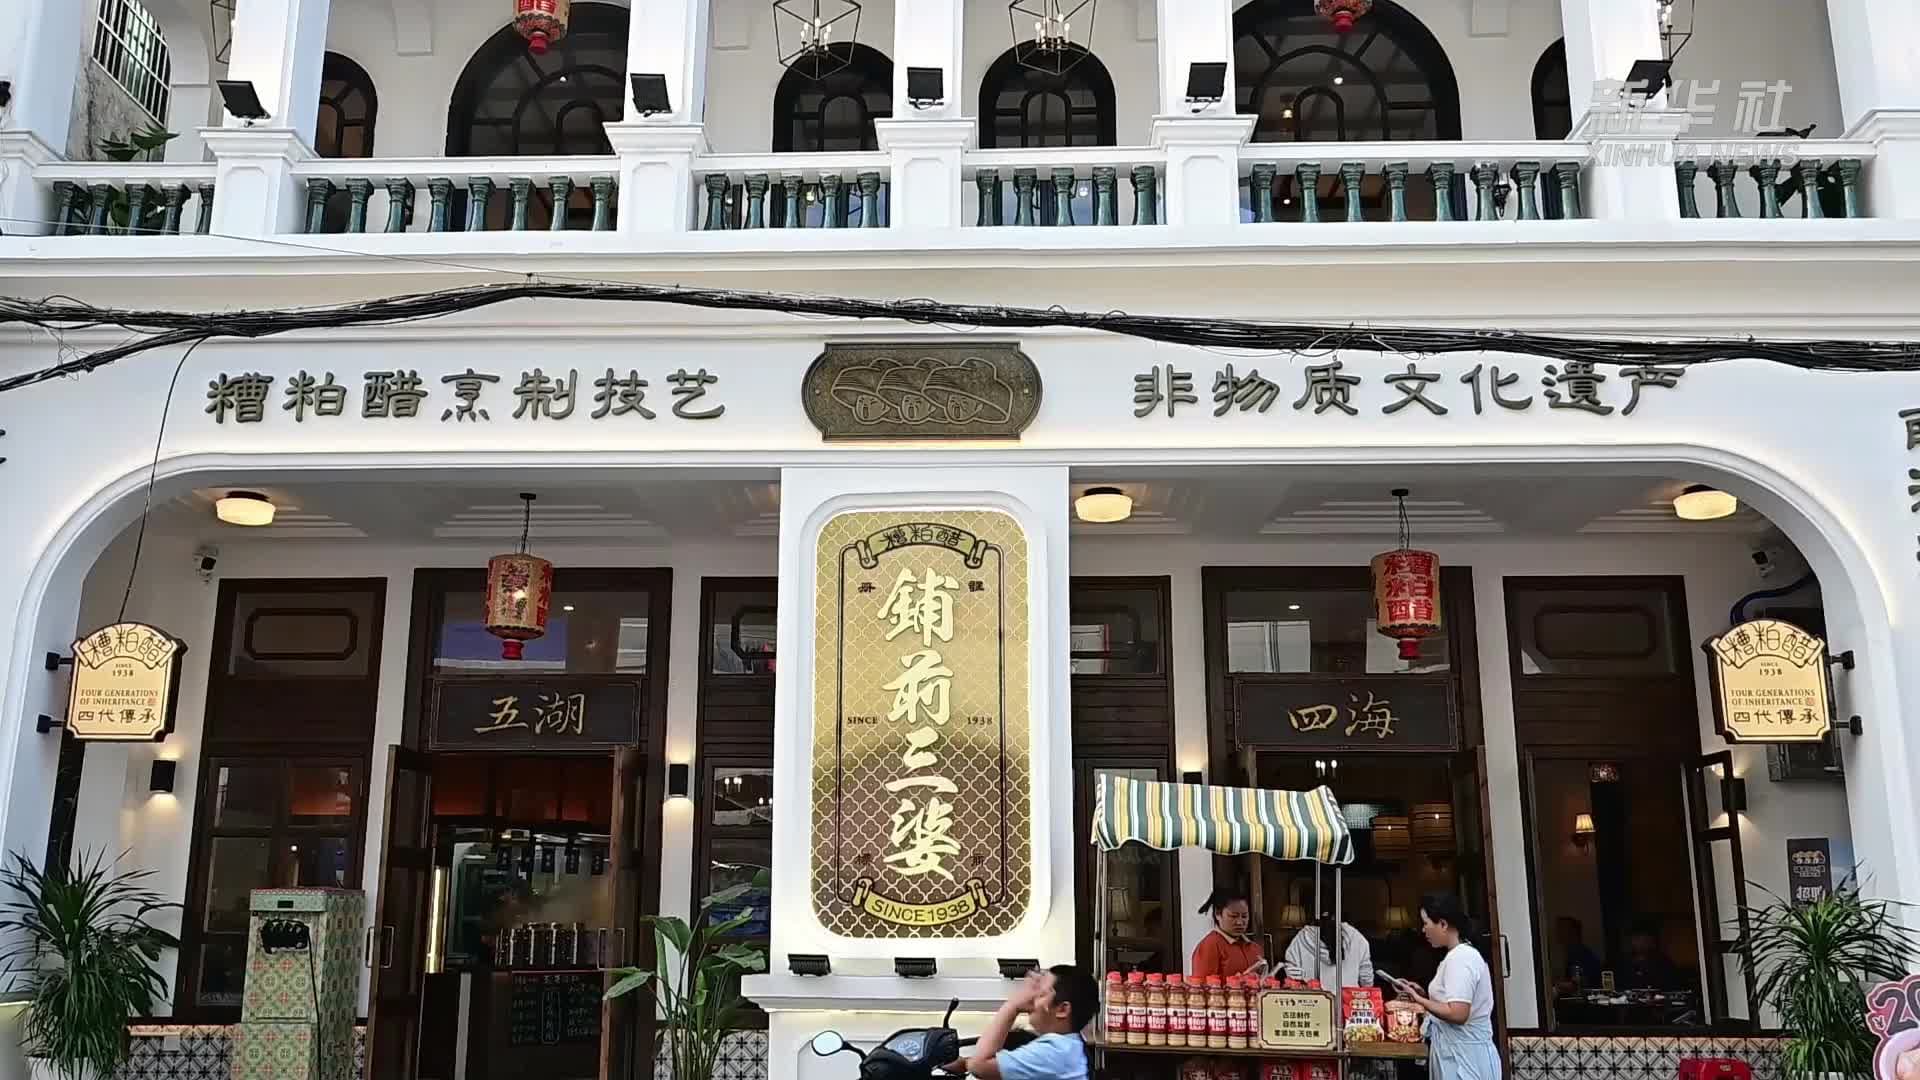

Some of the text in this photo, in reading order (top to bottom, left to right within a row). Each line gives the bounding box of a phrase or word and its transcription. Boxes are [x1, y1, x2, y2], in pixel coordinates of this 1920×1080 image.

[205, 368, 726, 424] 糟粕醋烹制技艺
[1760, 668, 1782, 676] 1938
[81, 689, 158, 697] FOUR GENERATIONS
[1731, 689, 1815, 697] FOUR GENERATIONS
[80, 698, 145, 706] OF INHERITANCE
[1731, 698, 1803, 706] OF INHERITANCE
[78, 707, 157, 724] 四代傳承
[473, 692, 585, 735] 五湖
[1288, 691, 1400, 738] 四海
[1734, 708, 1819, 724] 四代傳承
[847, 716, 993, 726] SINCE 1938
